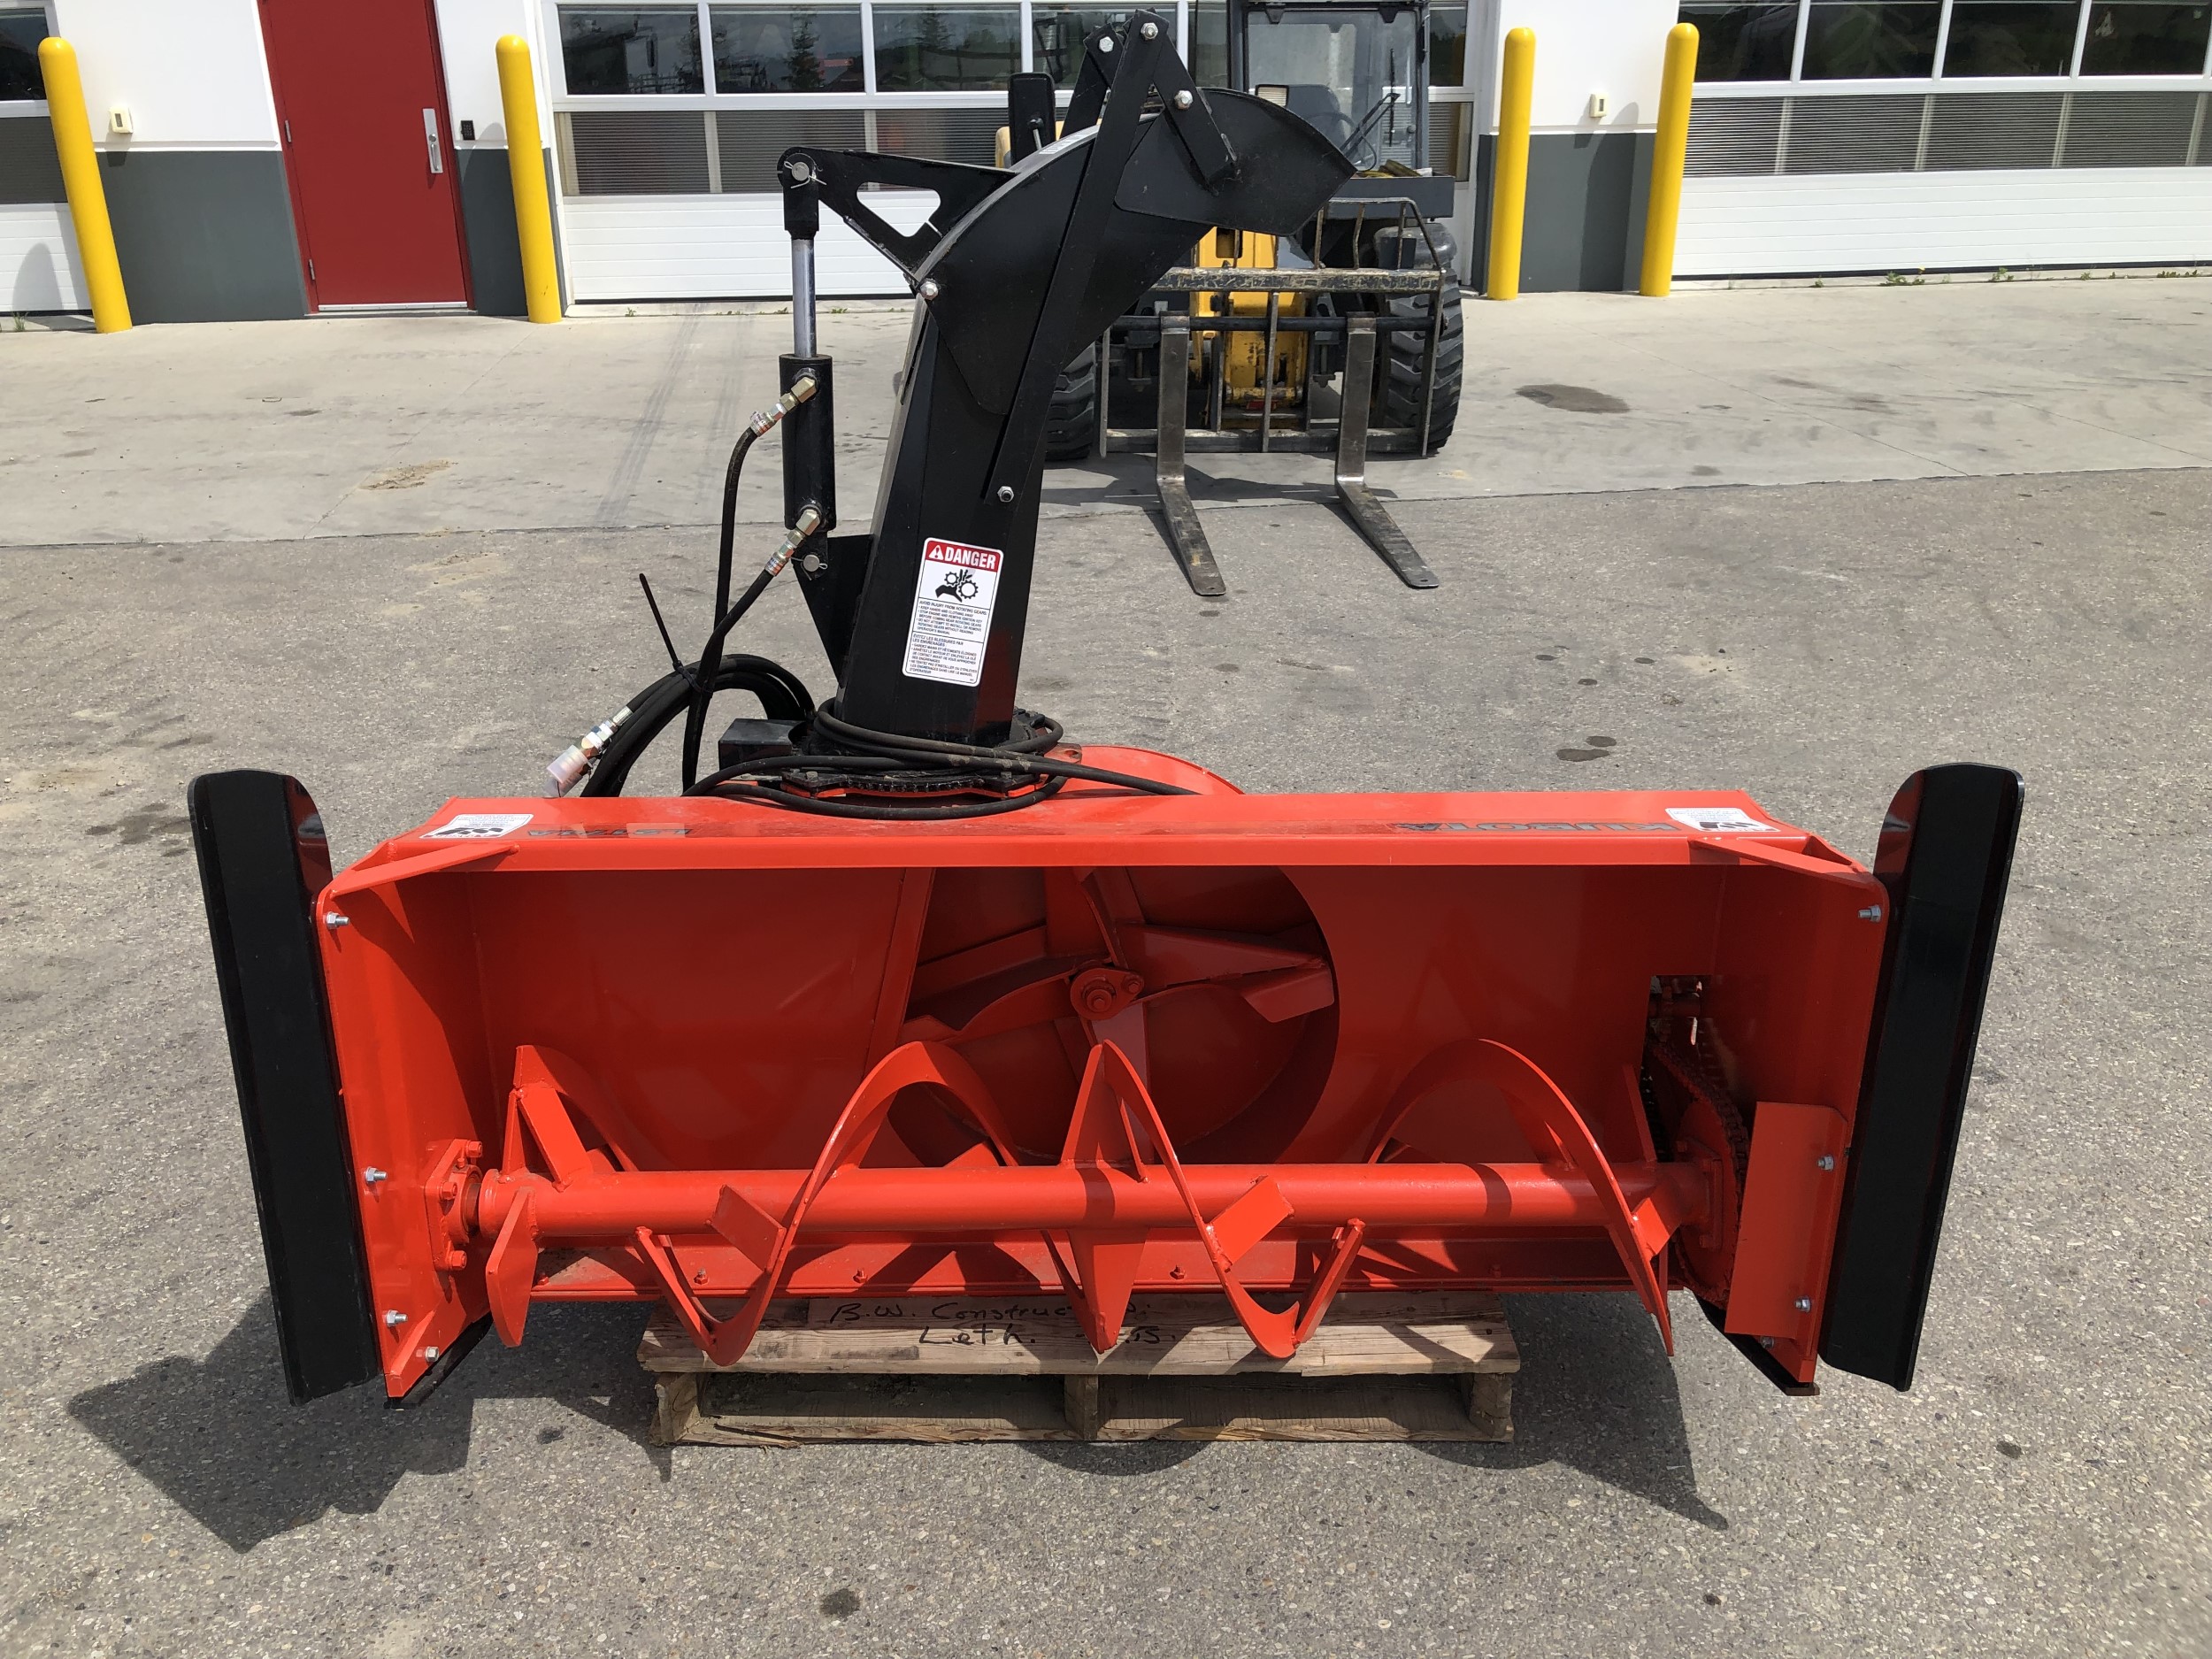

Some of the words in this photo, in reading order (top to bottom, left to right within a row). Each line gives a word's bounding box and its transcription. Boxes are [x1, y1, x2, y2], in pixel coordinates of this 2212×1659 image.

[944, 546, 997, 571] DANGER
[1390, 822, 1680, 832] KUBOTA
[829, 1302, 916, 1324] B.W.
